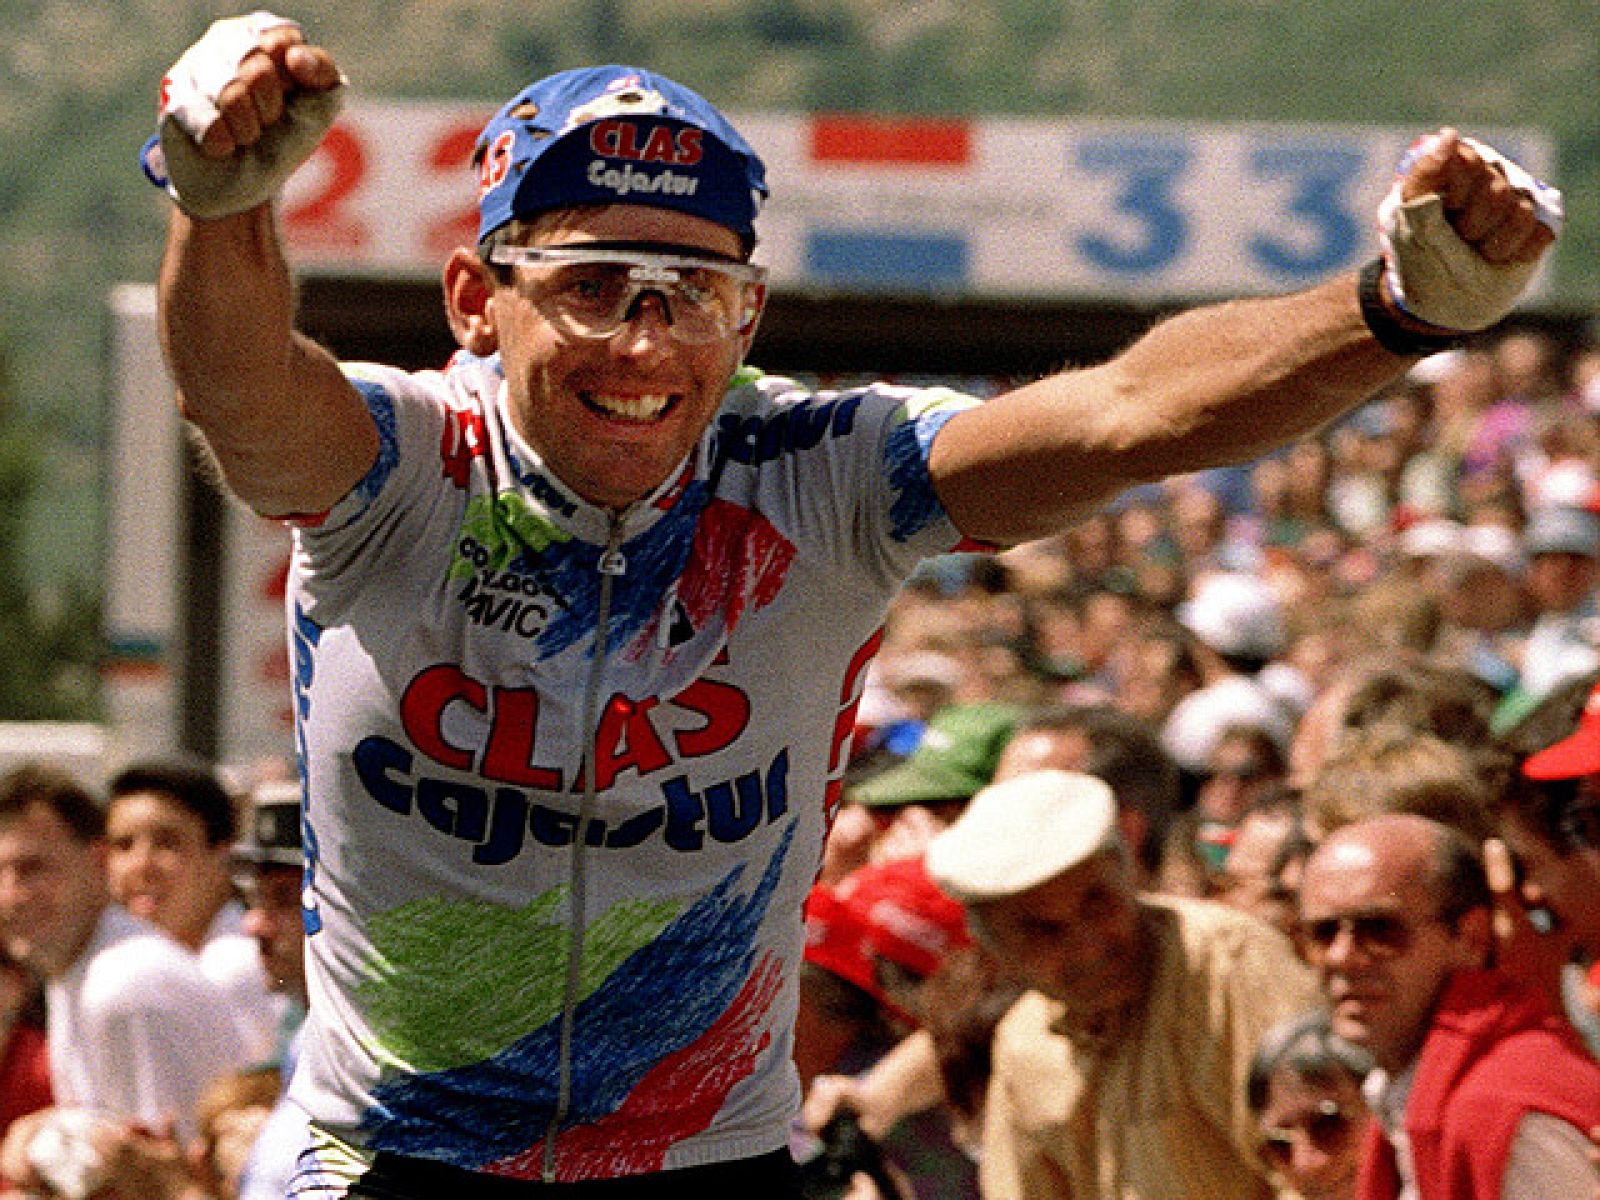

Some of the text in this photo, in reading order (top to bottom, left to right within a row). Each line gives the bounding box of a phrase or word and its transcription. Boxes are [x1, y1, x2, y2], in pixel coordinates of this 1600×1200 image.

[590, 121, 704, 165] CLAS
[586, 158, 698, 196] Cajastur
[401, 645, 752, 794] CLAS
